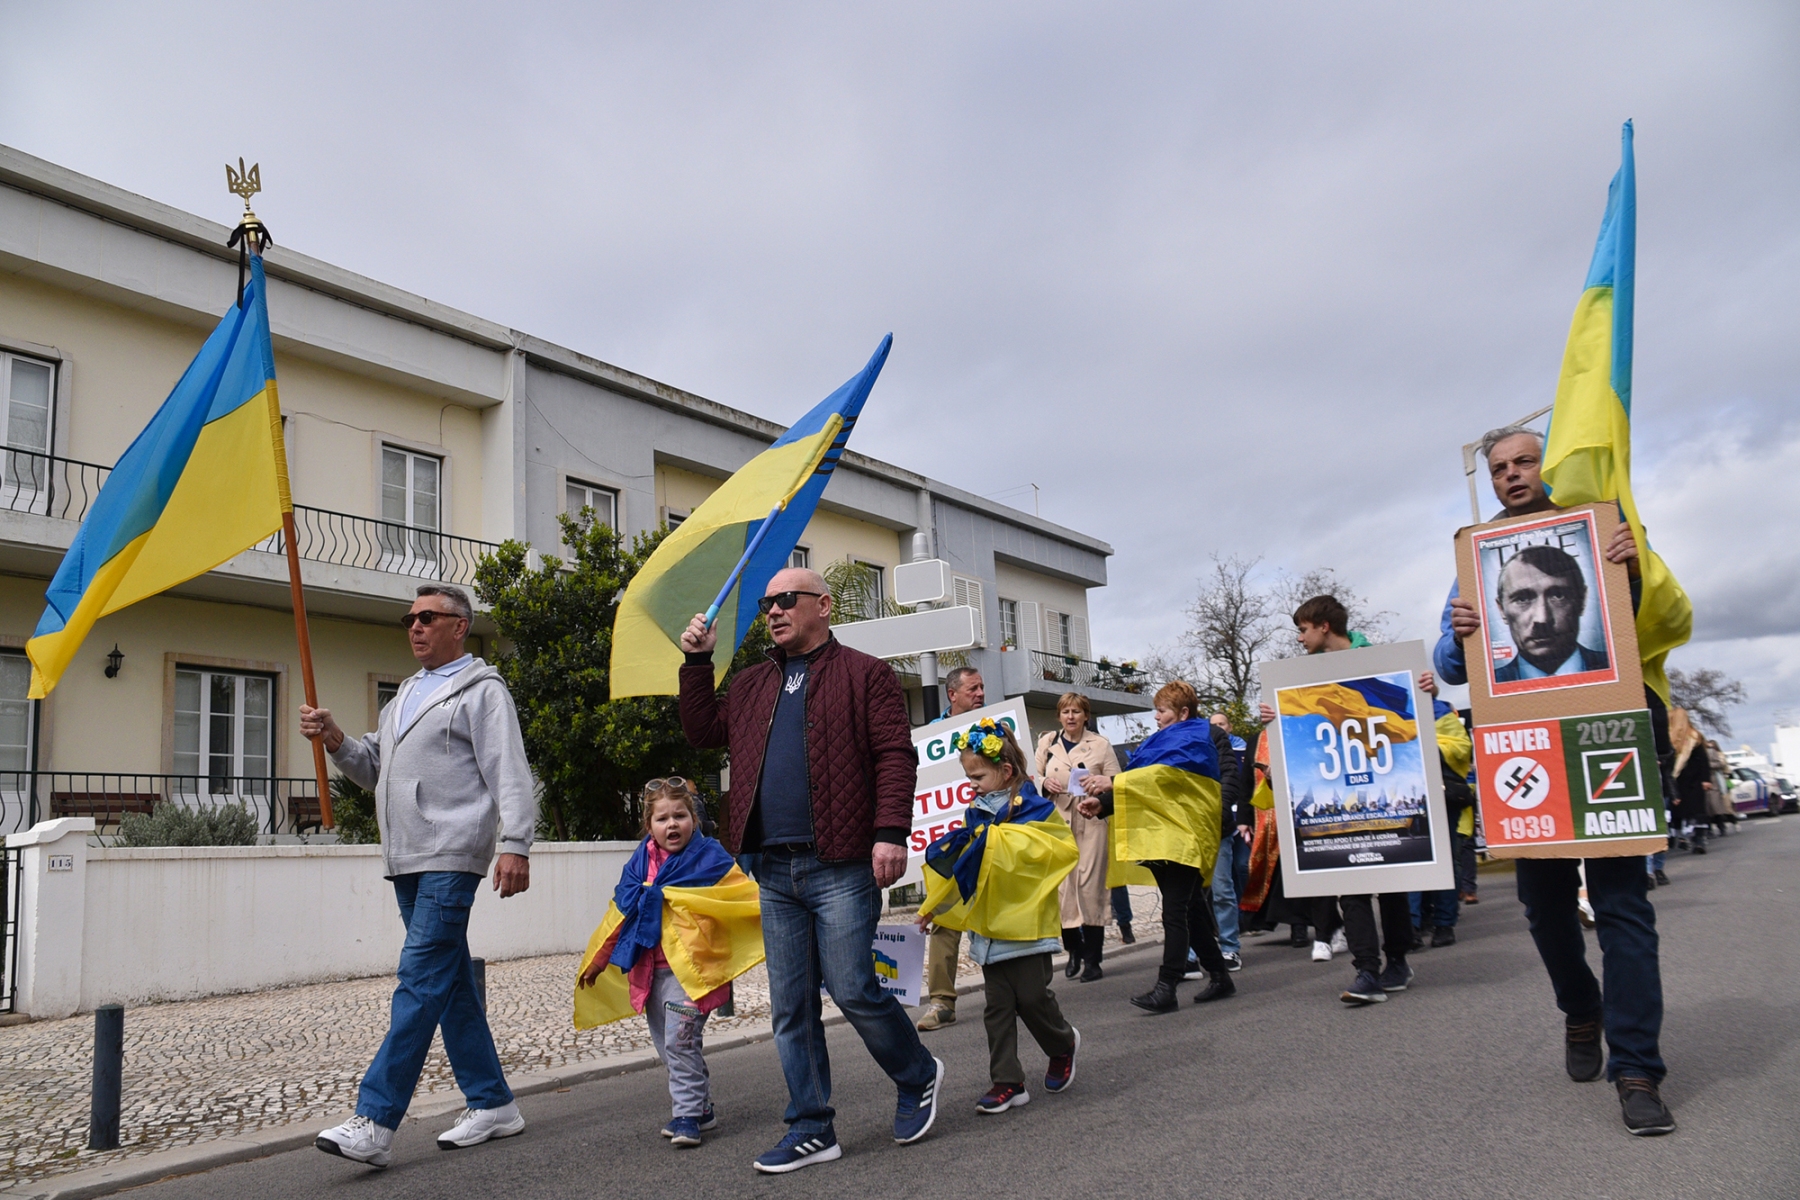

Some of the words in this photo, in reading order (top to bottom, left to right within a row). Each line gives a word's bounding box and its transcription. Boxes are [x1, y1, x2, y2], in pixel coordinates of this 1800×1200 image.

[1480, 537, 1510, 549] Person
[1510, 534, 1519, 544] of
[1519, 531, 1534, 541] the
[1489, 531, 1580, 571] TE
[1483, 727, 1552, 755] NEVER
[1576, 718, 1638, 746] 2022
[1316, 715, 1393, 780] 365
[1349, 774, 1370, 785] DIAS
[1301, 818, 1310, 826] DE
[1310, 814, 1333, 824] INVASÃO
[1333, 815, 1342, 823] EM
[1342, 812, 1366, 822] GRANDE
[1366, 810, 1389, 819] ESCALA
[1389, 809, 1398, 818] DA
[1499, 814, 1556, 840] 1939
[1584, 808, 1657, 836] AGAIN
[1303, 838, 1323, 846] MOSTRE
[1333, 836, 1349, 844] APOIO
[1376, 832, 1399, 840] UCRÂNIA
[1374, 838, 1402, 847] FEVEREIRO
[51, 859, 71, 868] 115
